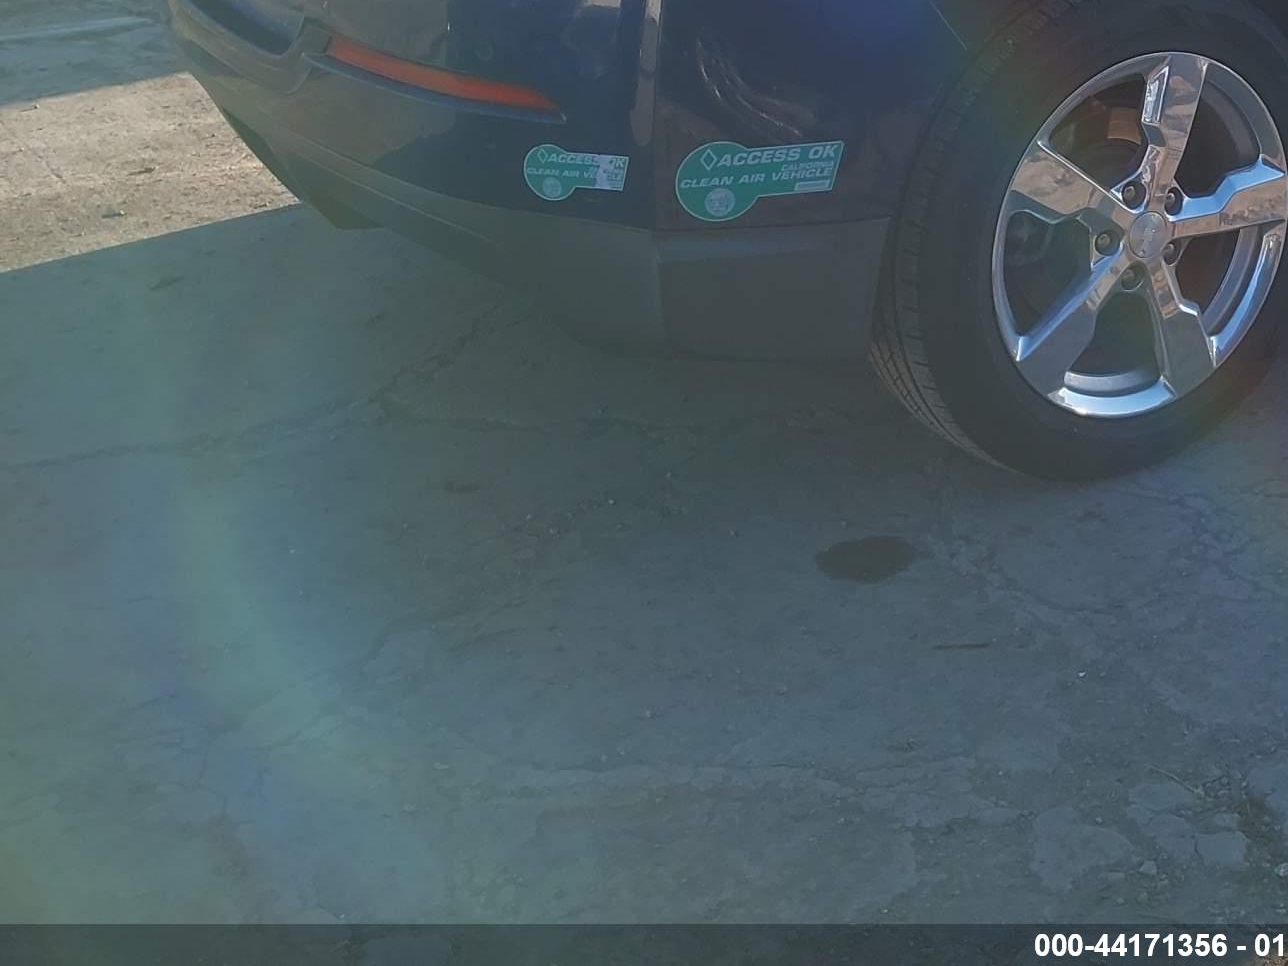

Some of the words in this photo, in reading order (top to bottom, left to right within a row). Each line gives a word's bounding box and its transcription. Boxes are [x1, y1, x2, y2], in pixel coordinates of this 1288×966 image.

[717, 149, 800, 167] ACCESS
[808, 145, 839, 159] OK
[526, 167, 559, 176] CLEAN
[562, 169, 580, 178] AIR
[680, 176, 734, 188] CLEAN
[738, 173, 765, 184] AIR
[772, 168, 833, 181] VEHICLE
